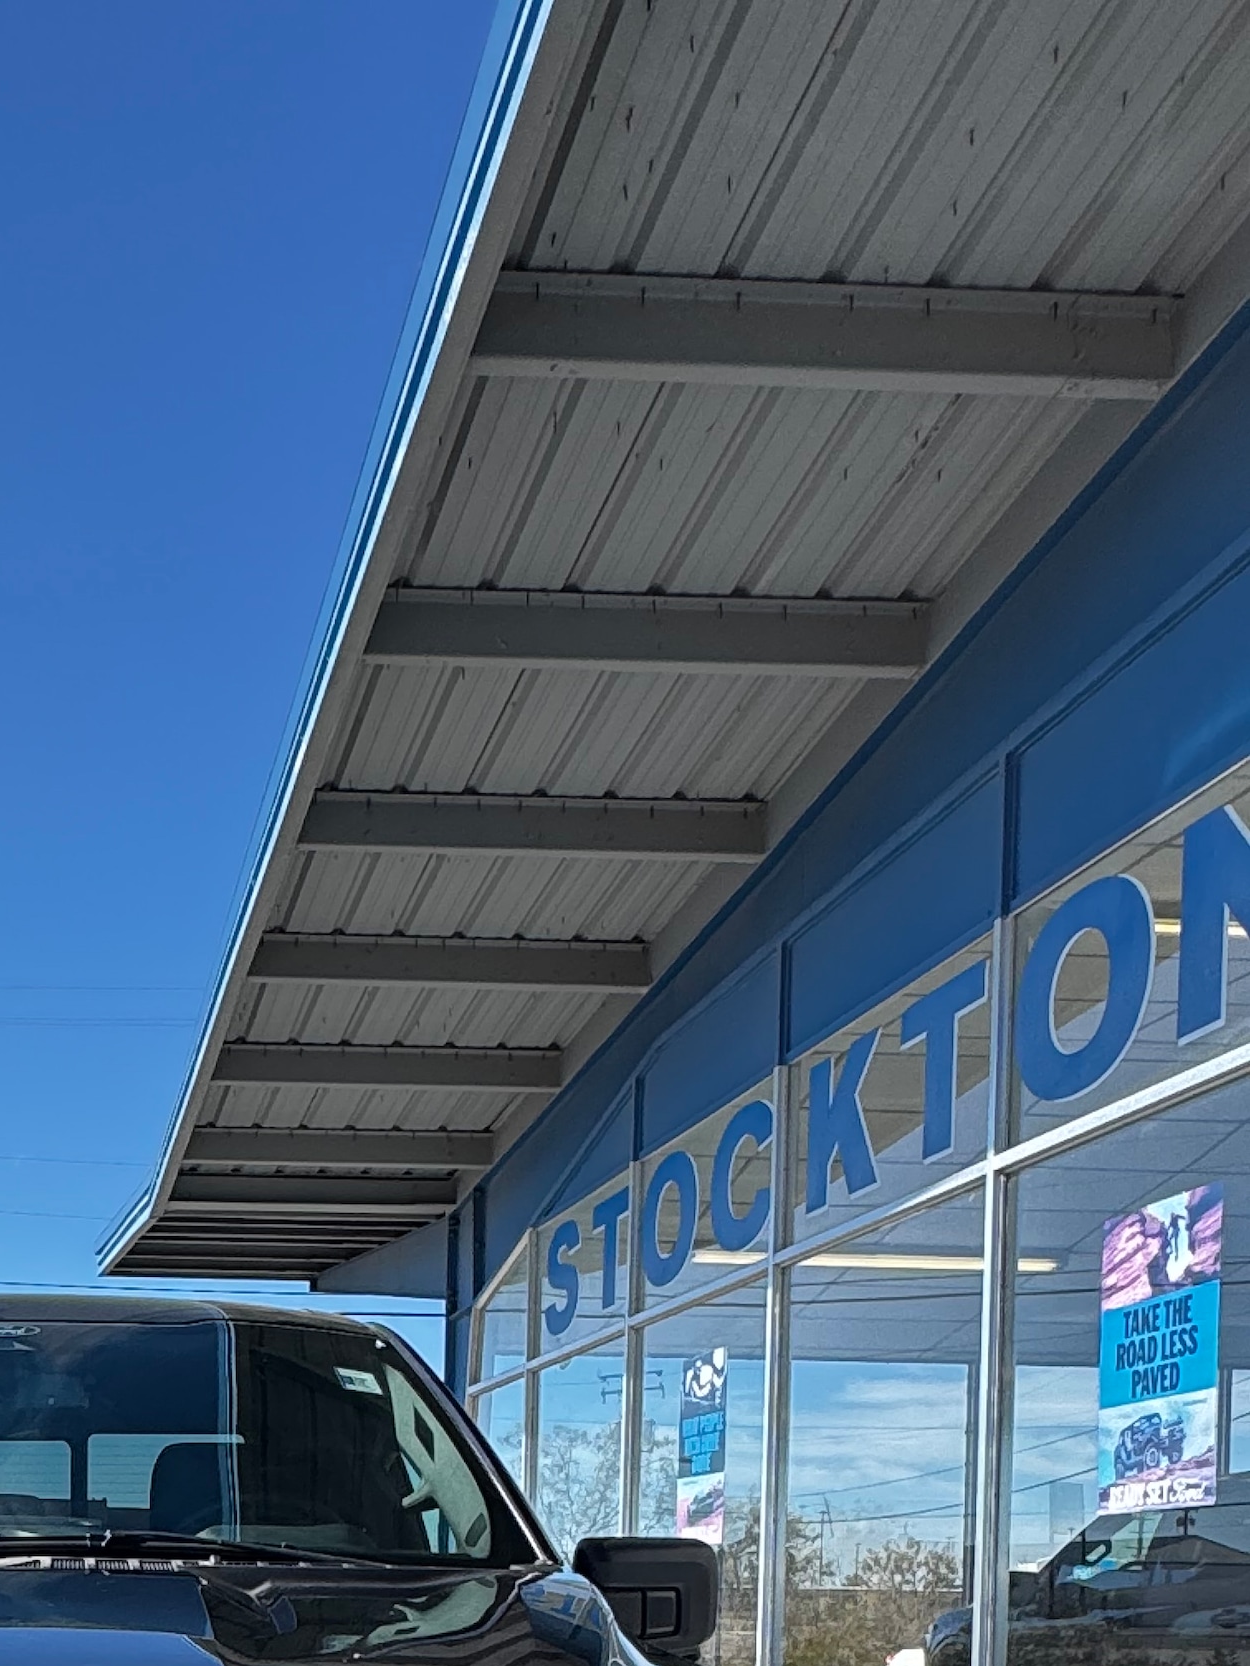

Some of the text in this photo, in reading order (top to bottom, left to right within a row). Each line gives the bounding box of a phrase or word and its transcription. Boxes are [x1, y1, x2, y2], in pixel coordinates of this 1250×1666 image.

[1123, 1294, 1193, 1339] TAKE THE
[1115, 1325, 1198, 1371] ROAD LESS
[1131, 1362, 1180, 1399] PAVED
[1146, 1479, 1171, 1505] SET
